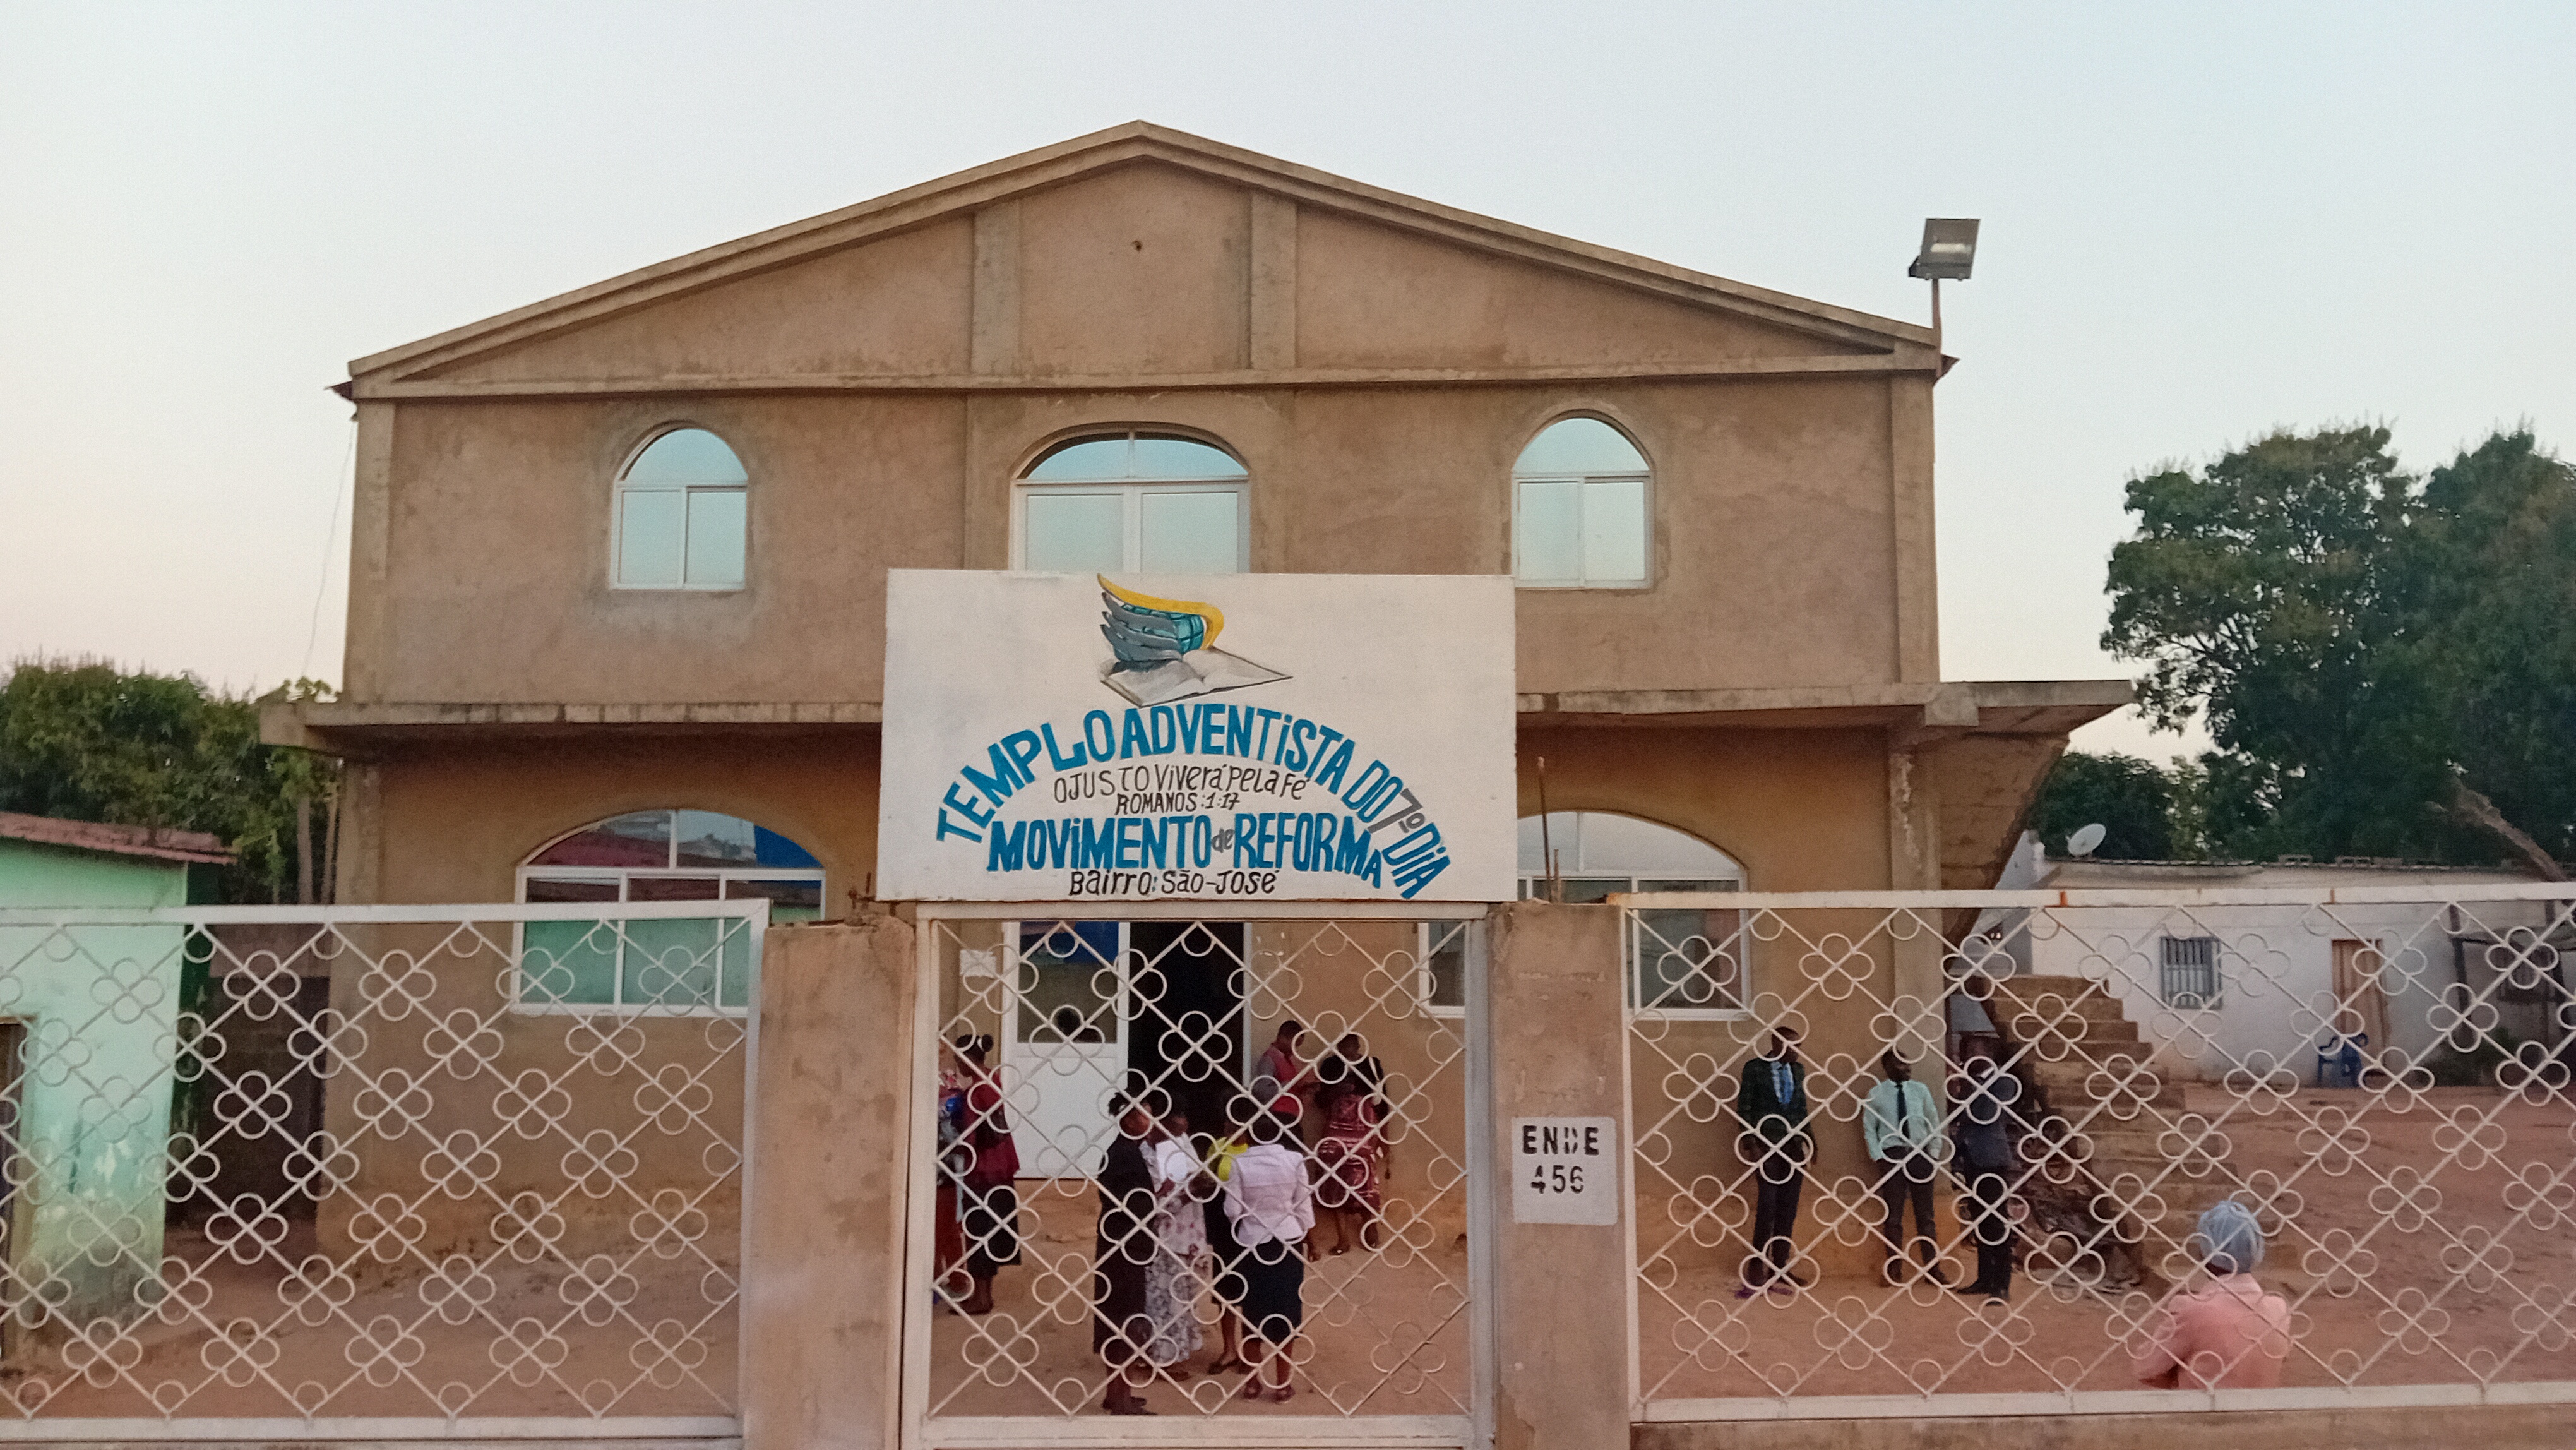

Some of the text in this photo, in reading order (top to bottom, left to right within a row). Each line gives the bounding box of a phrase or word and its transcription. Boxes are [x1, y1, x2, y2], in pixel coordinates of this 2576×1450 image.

[936, 710, 1116, 844] TEMPLO
[1341, 760, 1404, 823] DO
[1212, 827, 1235, 853] de
[1233, 812, 1382, 889] REFORMA
[1522, 1125, 1599, 1156] ENDE
[1530, 1165, 1584, 1194] 456
